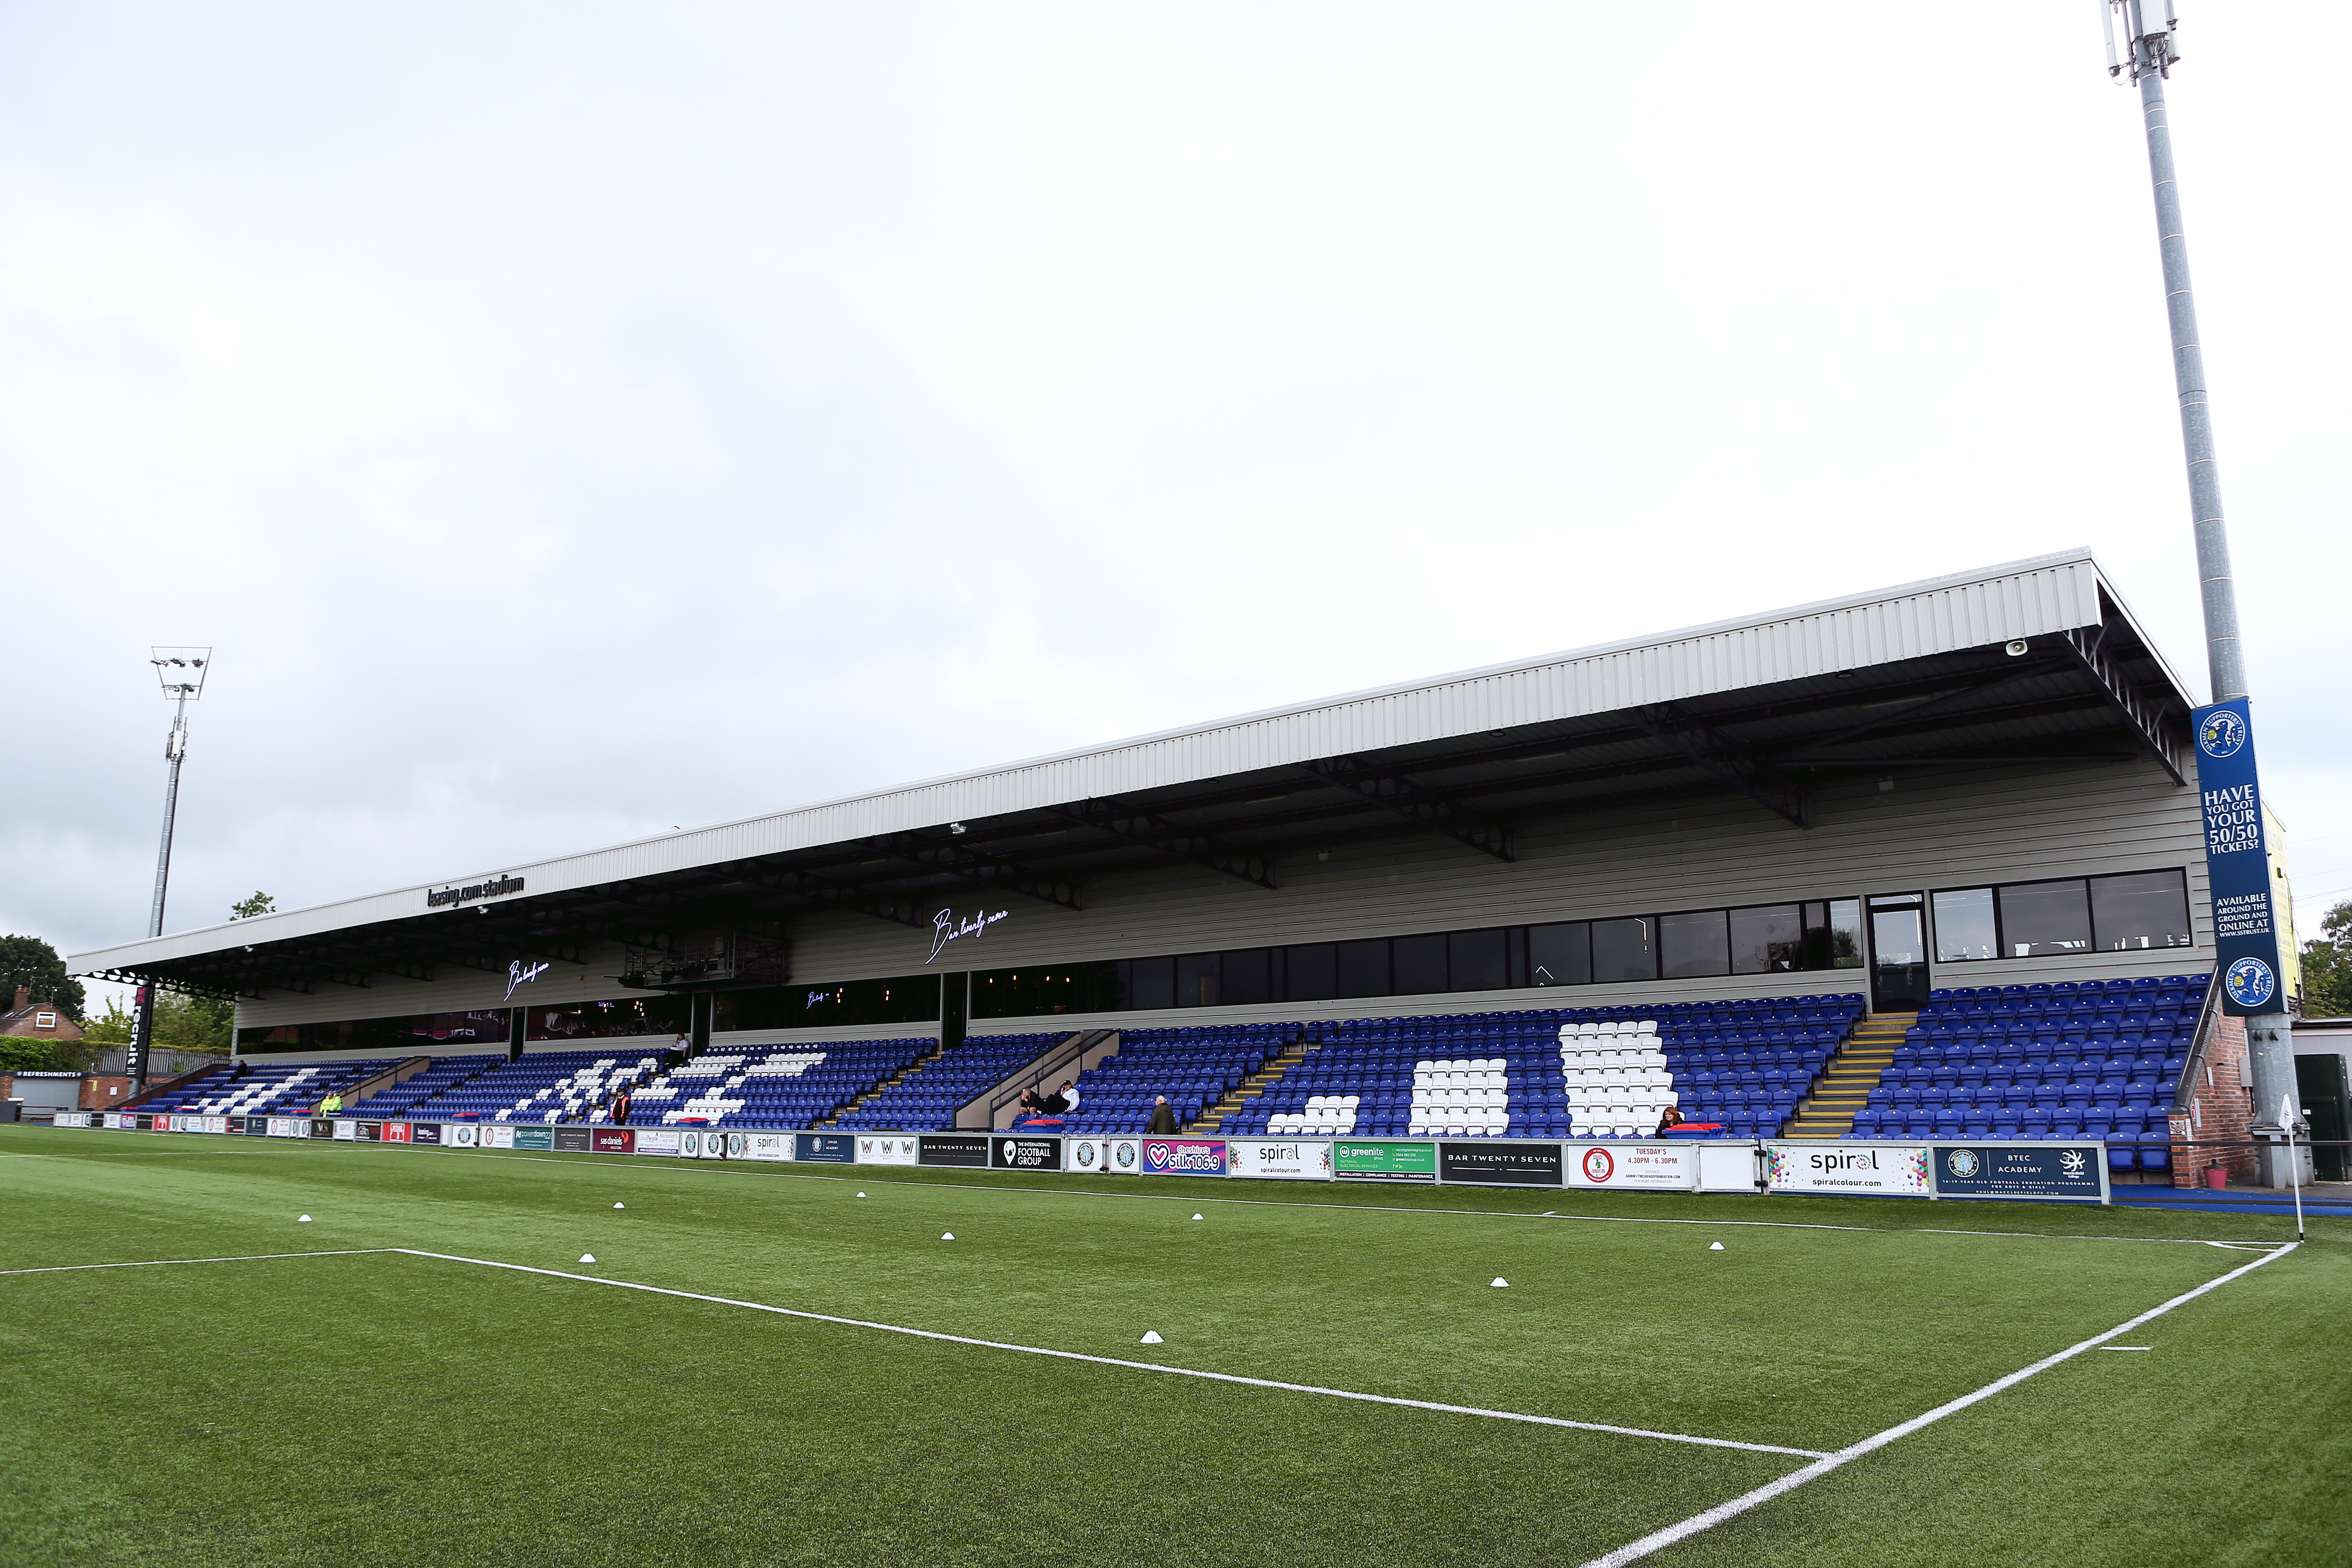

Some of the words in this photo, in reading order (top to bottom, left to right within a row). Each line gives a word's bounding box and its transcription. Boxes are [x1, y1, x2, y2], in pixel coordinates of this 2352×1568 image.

[2202, 727, 2212, 752] SILKMEN
[2235, 726, 2243, 745] TRUST
[2204, 784, 2254, 806] HAVE
[2206, 804, 2229, 814] YOU
[2232, 799, 2254, 810] GOT
[2207, 809, 2256, 828] YOUR
[2209, 823, 2258, 845] 50/50
[2210, 839, 2258, 855] TICKETS?
[428, 884, 482, 907] leasing.com
[482, 874, 524, 897] stadium
[2216, 893, 2266, 907] AVAILABLE
[2217, 905, 2251, 915] AROUND
[2218, 913, 2249, 923] GROUND
[2219, 920, 2254, 932] ONLINE
[2256, 919, 2268, 927] AT
[2219, 927, 2269, 937] WWW.SSTRUST.UK
[925, 908, 959, 964] Bar
[960, 909, 986, 937] twenty
[987, 910, 1008, 925] seven
[2228, 972, 2240, 999] SILKMEN
[2263, 976, 2272, 996] TRUST
[128, 1005, 142, 1065] recruit
[607, 1136, 622, 1145] daniels
[1018, 1148, 1051, 1157] FOOTBALL
[1176, 1145, 1211, 1154] Cheshire's
[1351, 1148, 1384, 1157] greenlite
[1018, 1156, 1042, 1166] GROUP
[1169, 1155, 1191, 1169] Silk
[1813, 1178, 1881, 1186] spiralcolour.com
